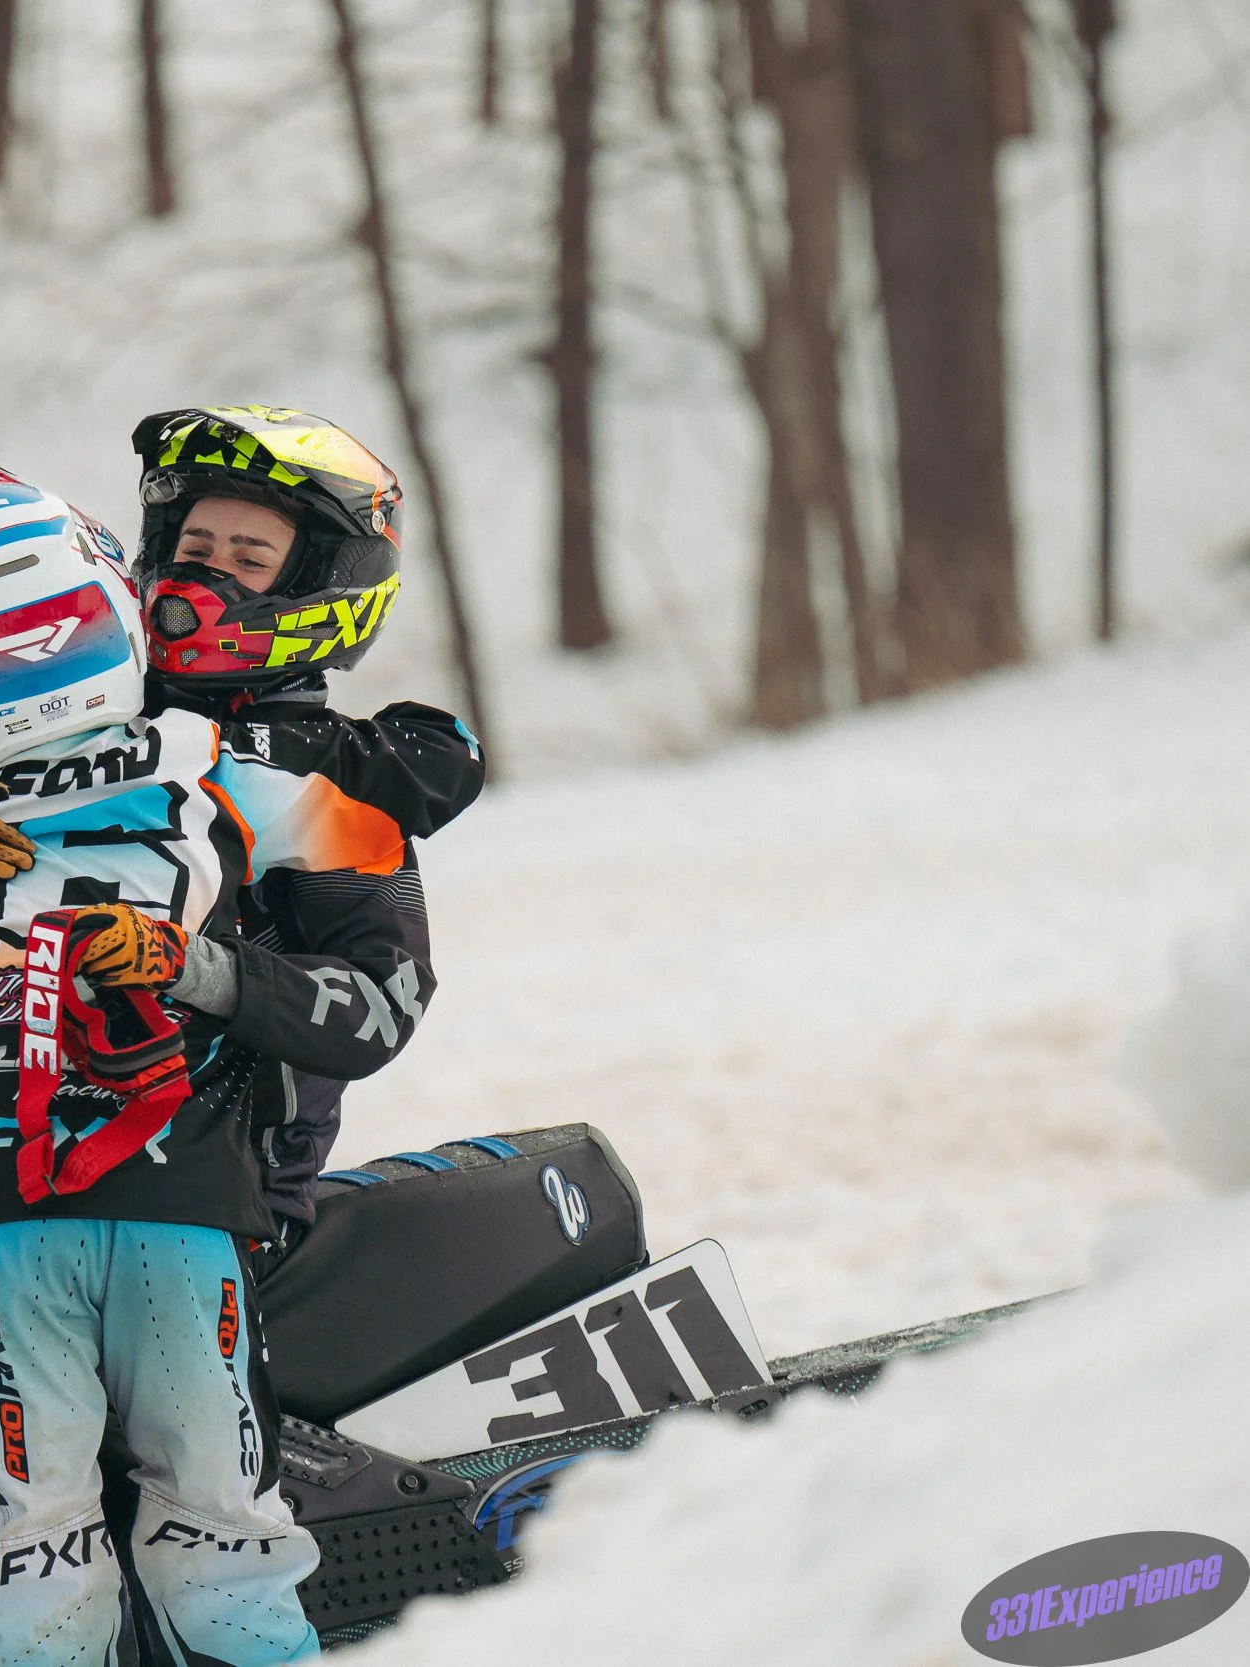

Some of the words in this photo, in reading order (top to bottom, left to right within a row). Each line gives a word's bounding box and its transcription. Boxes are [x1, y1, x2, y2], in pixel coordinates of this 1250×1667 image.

[40, 696, 70, 714] DOT
[23, 925, 64, 1076] RIDE
[304, 958, 423, 1049] FXR
[220, 1280, 238, 1355] PRO
[462, 1264, 766, 1445] 311
[1, 1402, 28, 1482] PRO
